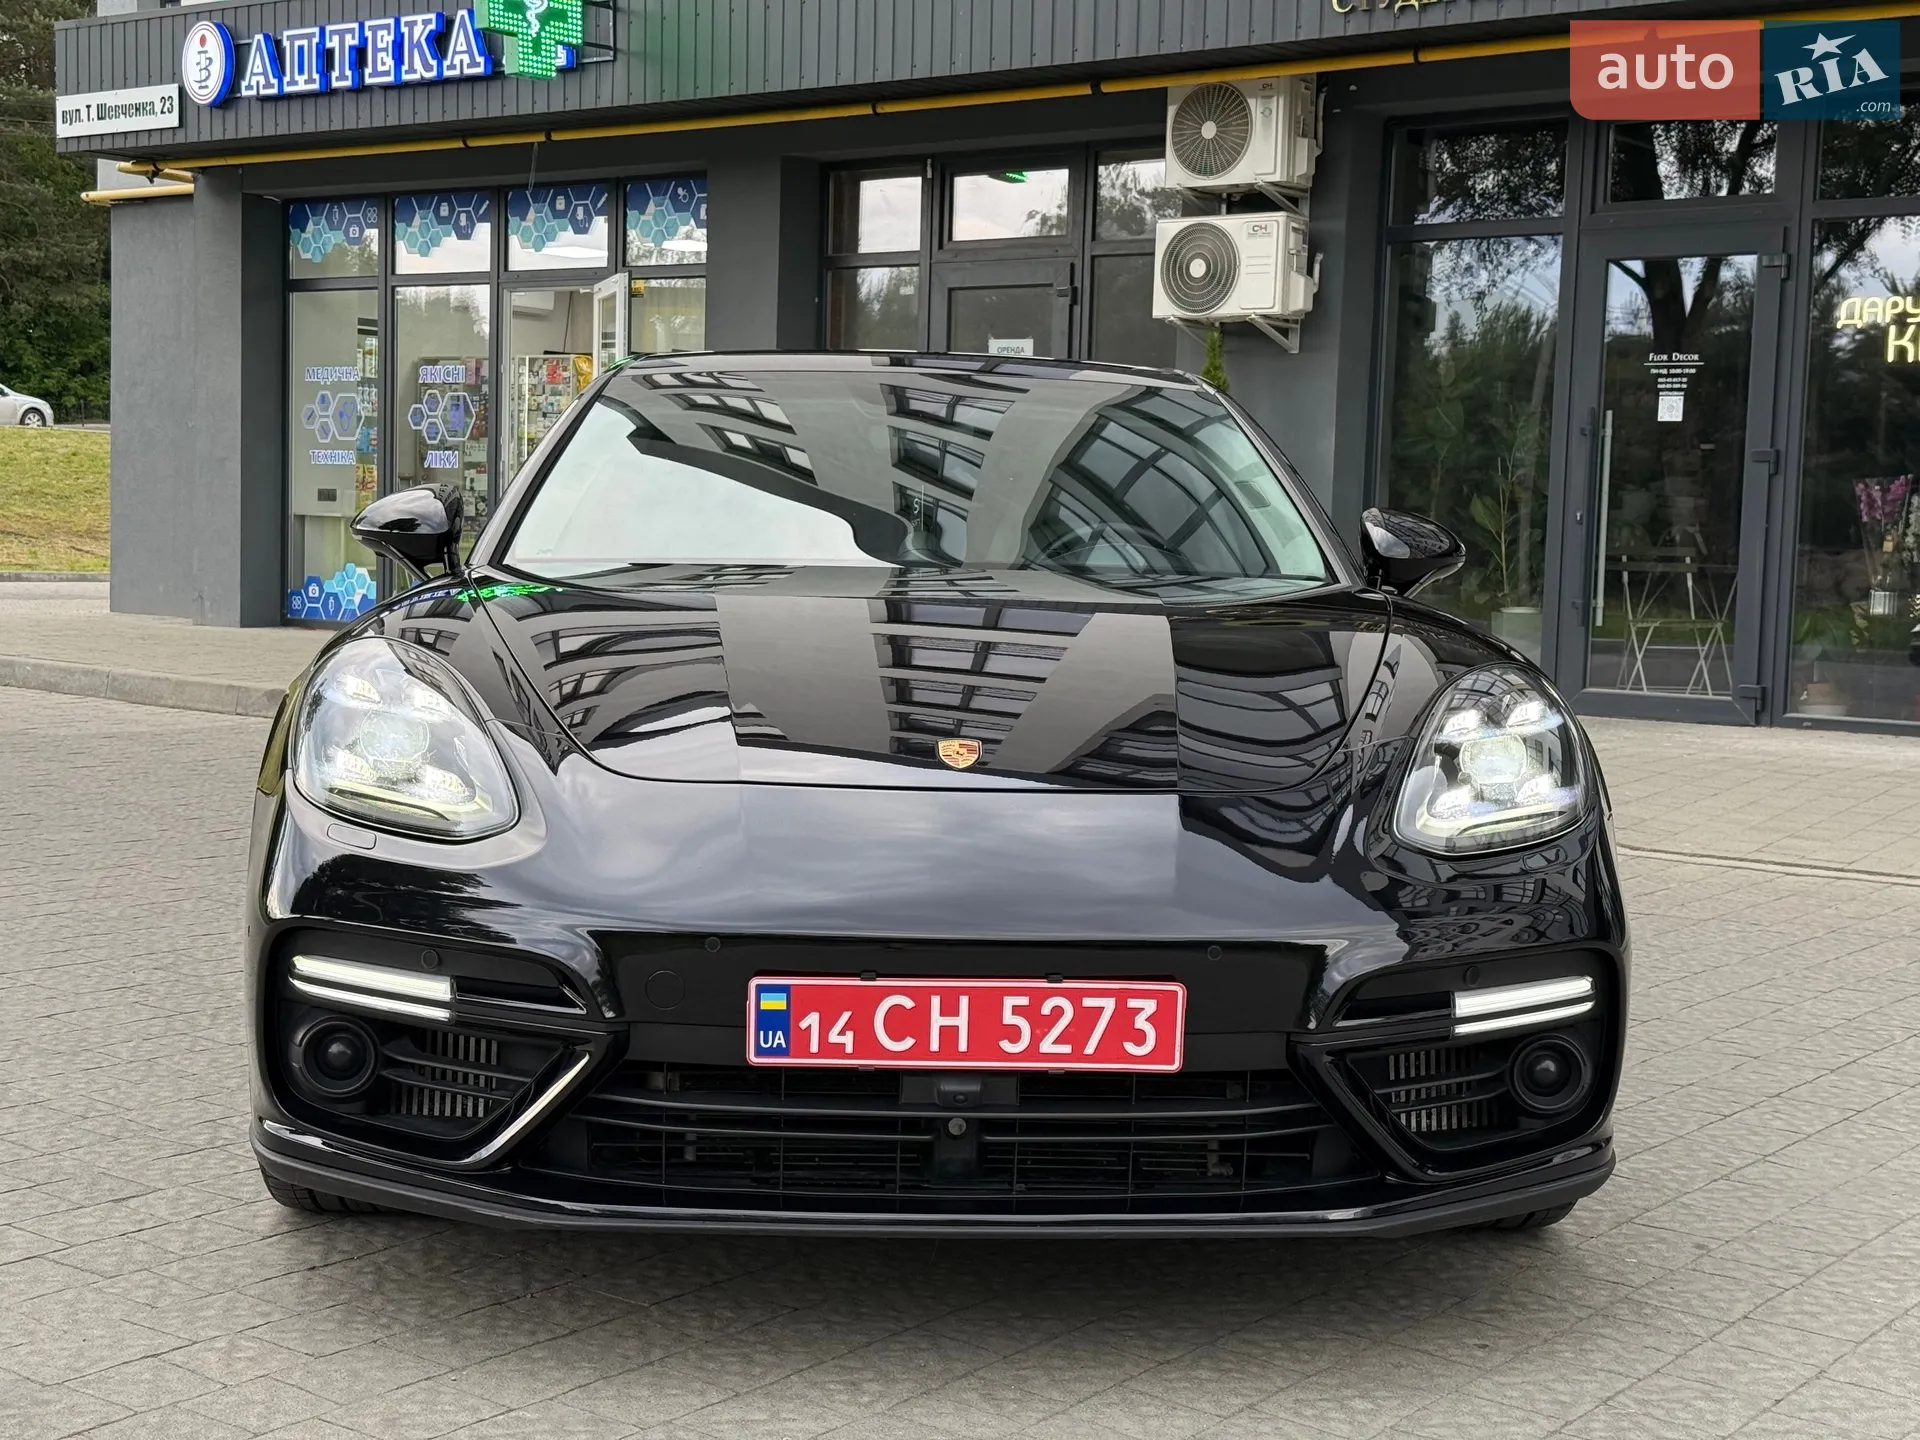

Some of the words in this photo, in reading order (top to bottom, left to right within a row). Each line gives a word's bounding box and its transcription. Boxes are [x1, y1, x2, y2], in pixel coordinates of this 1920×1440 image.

[241, 9, 493, 97] АПТЕКА
[62, 108, 83, 126] вул.
[86, 104, 95, 122] Т.
[96, 100, 158, 121] Шевченка,
[160, 95, 174, 115] 23
[997, 346, 1024, 354] ОРЕНДА
[1888, 325, 1920, 363] К
[304, 366, 361, 385] МЕДИЧНА
[419, 365, 466, 384] ЯКІСНІ
[309, 449, 357, 466] ТЕХНІКА
[424, 450, 459, 469] ЛІКИ
[798, 1011, 854, 1054] 14
[873, 994, 969, 1053] CH
[998, 996, 1158, 1057] 5273
[759, 1030, 786, 1049] UA
